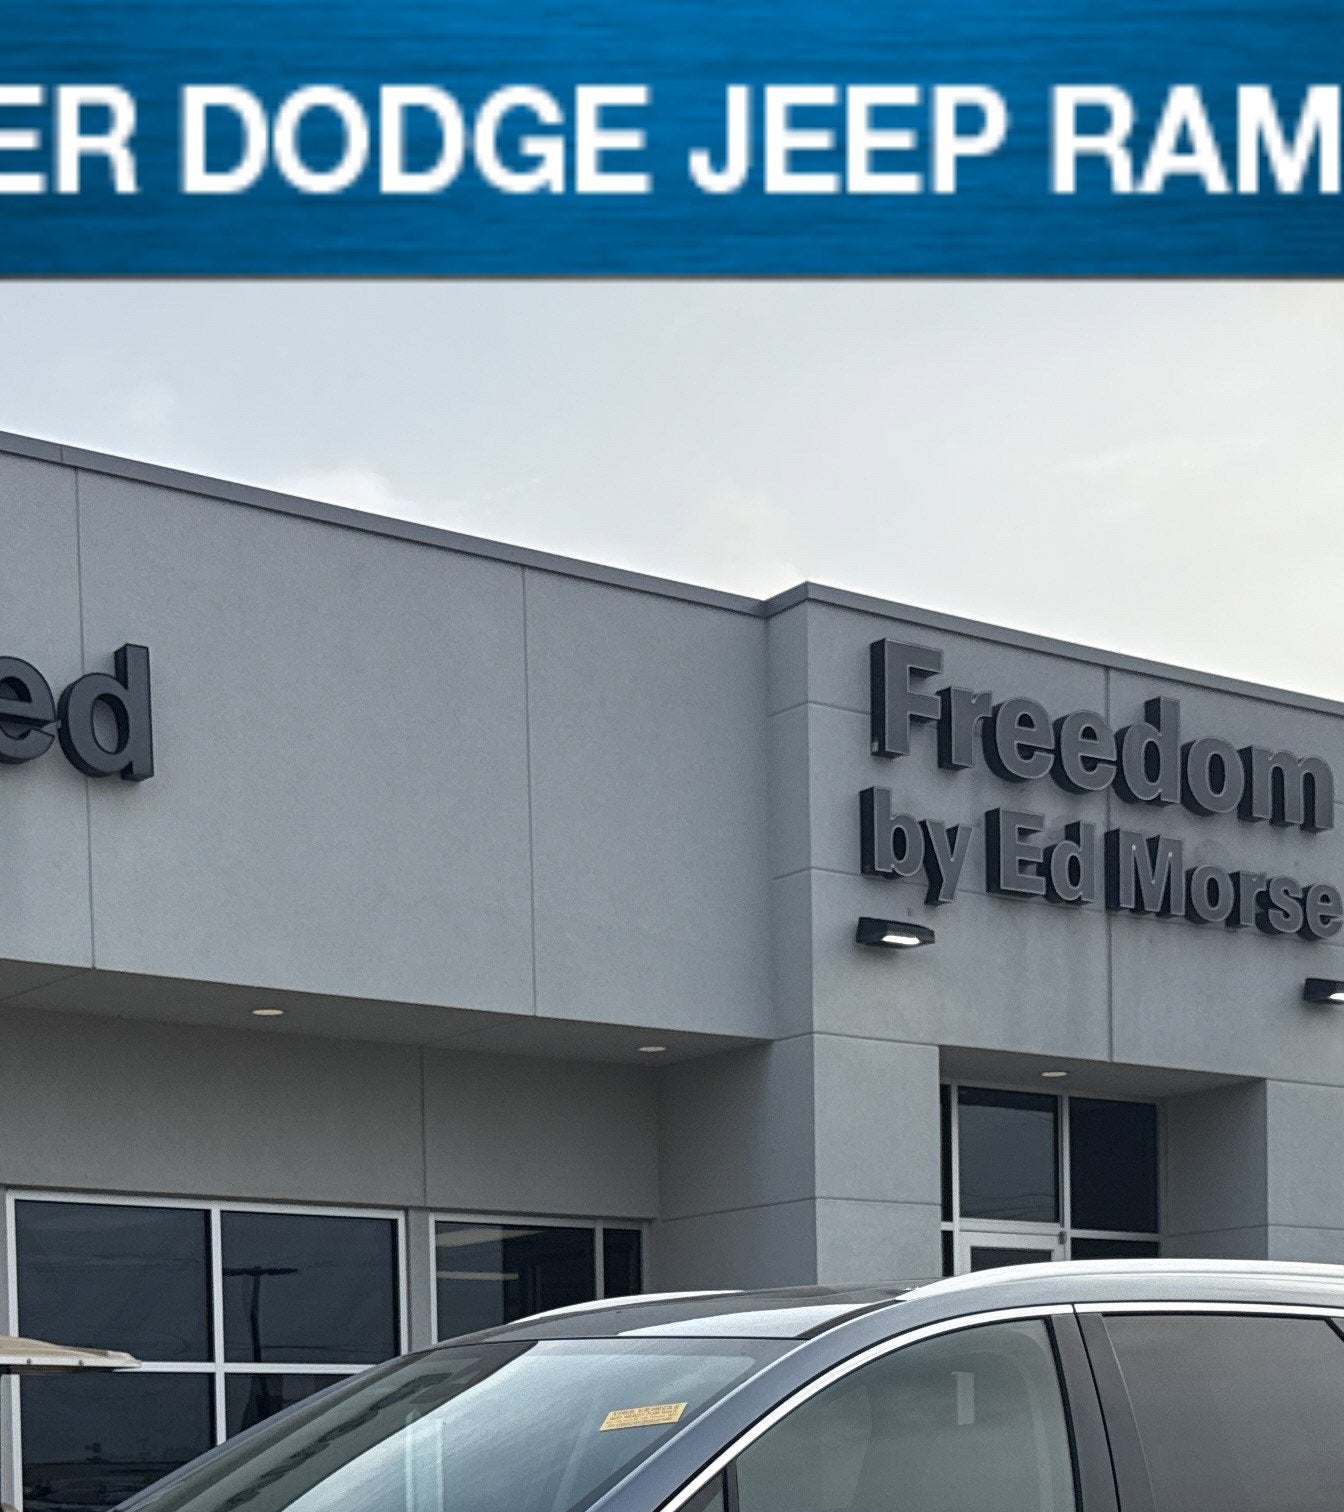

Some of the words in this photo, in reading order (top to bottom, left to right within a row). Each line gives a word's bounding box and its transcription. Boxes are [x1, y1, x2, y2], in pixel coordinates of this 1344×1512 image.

[870, 637, 1335, 832] Freedom
[860, 786, 972, 905] by
[985, 807, 1096, 905] Ed
[1105, 828, 1344, 942] Morse
